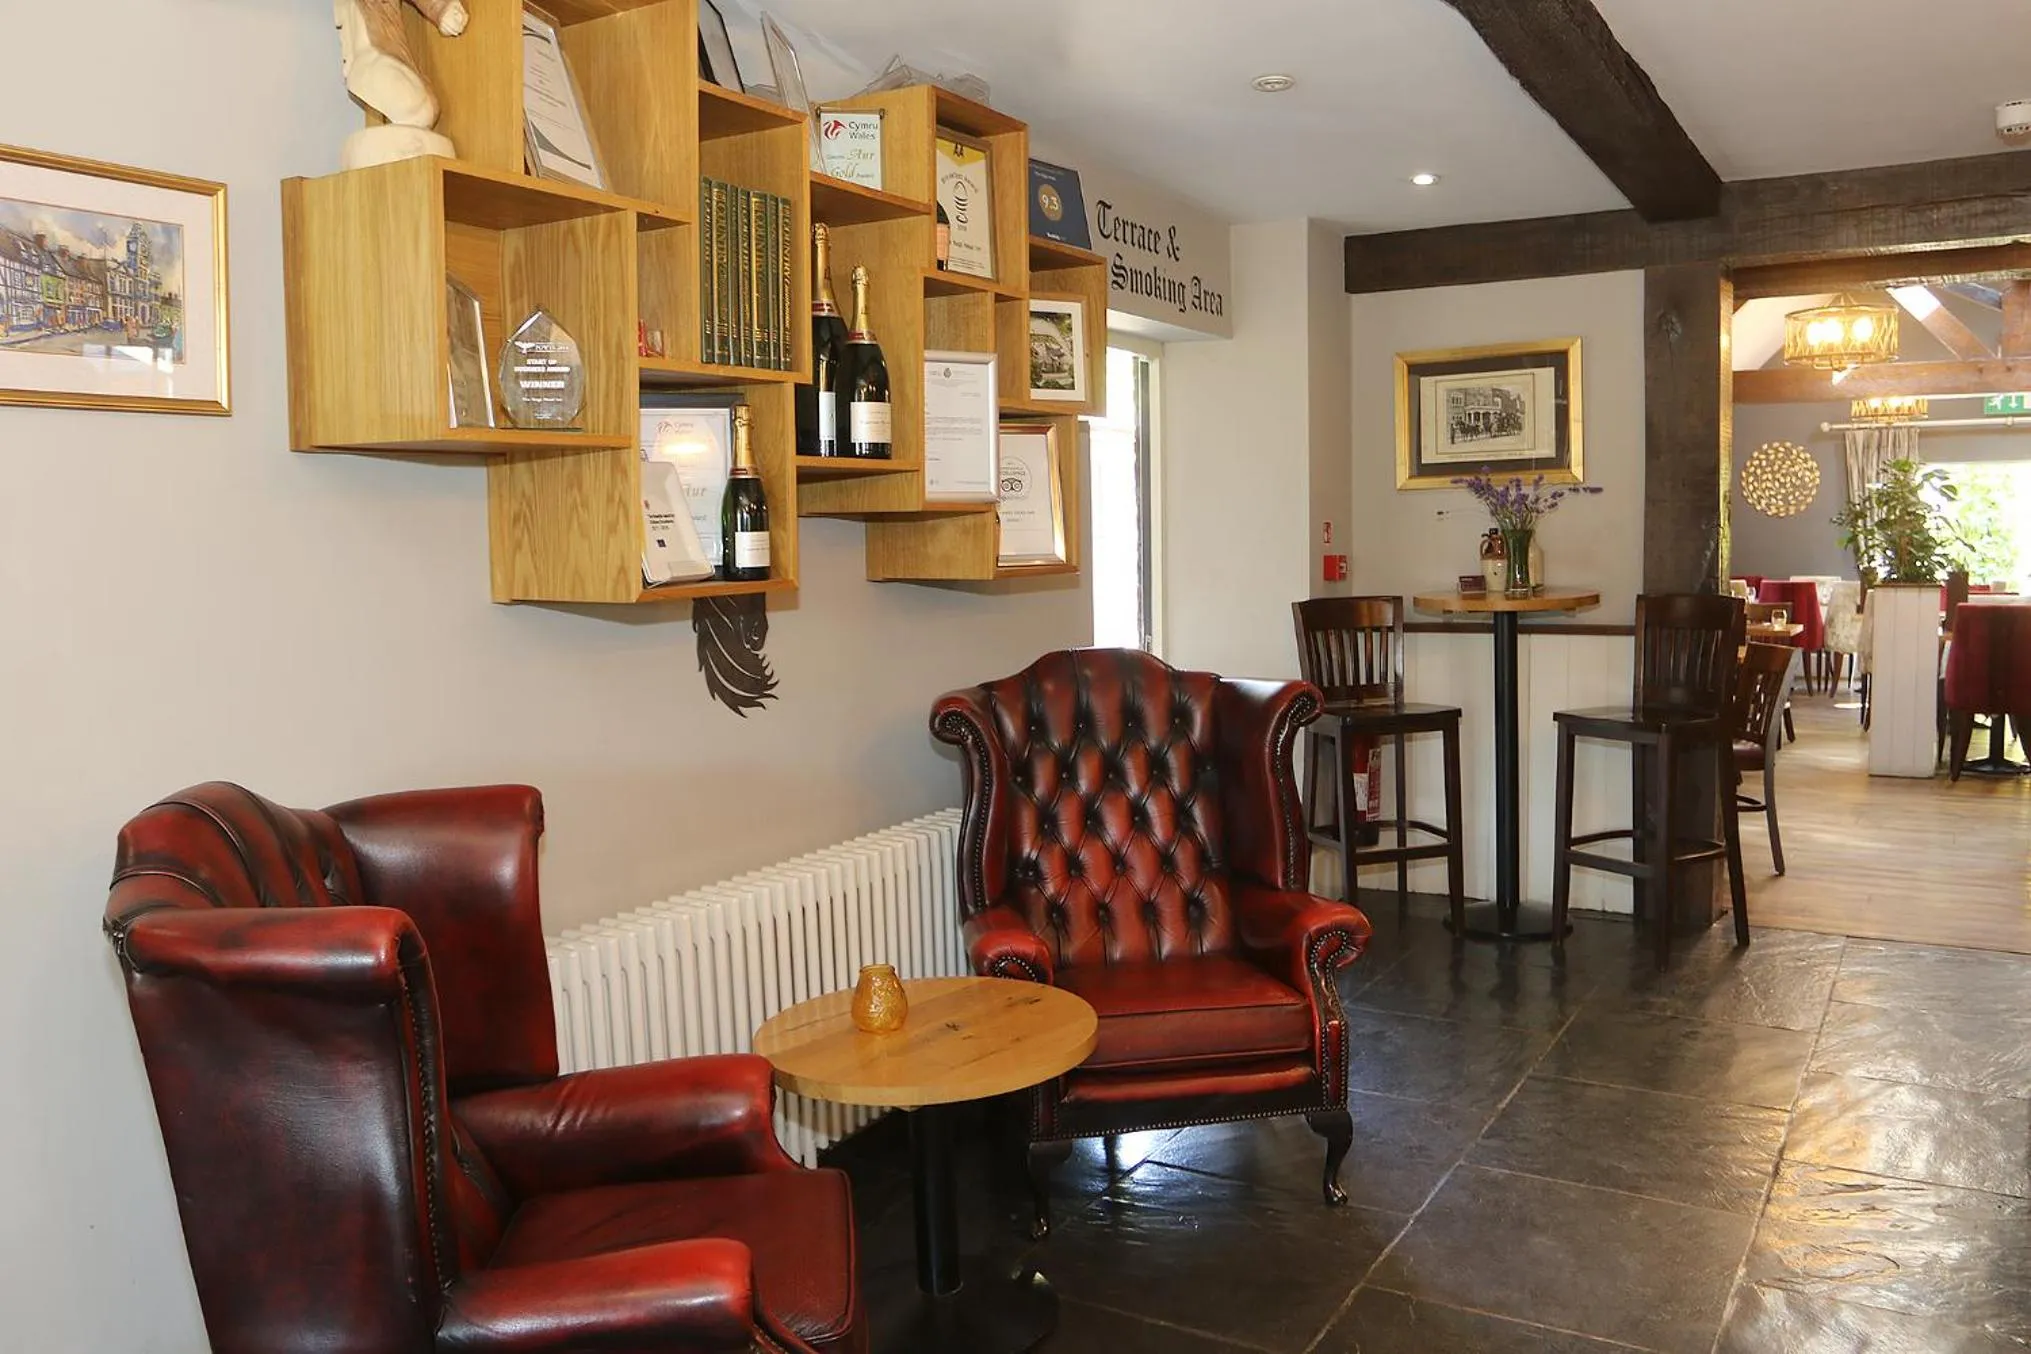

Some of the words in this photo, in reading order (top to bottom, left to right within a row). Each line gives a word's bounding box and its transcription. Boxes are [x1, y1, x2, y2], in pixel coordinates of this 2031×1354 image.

[848, 120, 879, 132] Cymru
[848, 131, 876, 140] Wales
[1095, 199, 1162, 255] Terrace
[1166, 225, 1181, 262] &
[1111, 252, 1186, 313] Smoking
[1191, 276, 1224, 317] Area
